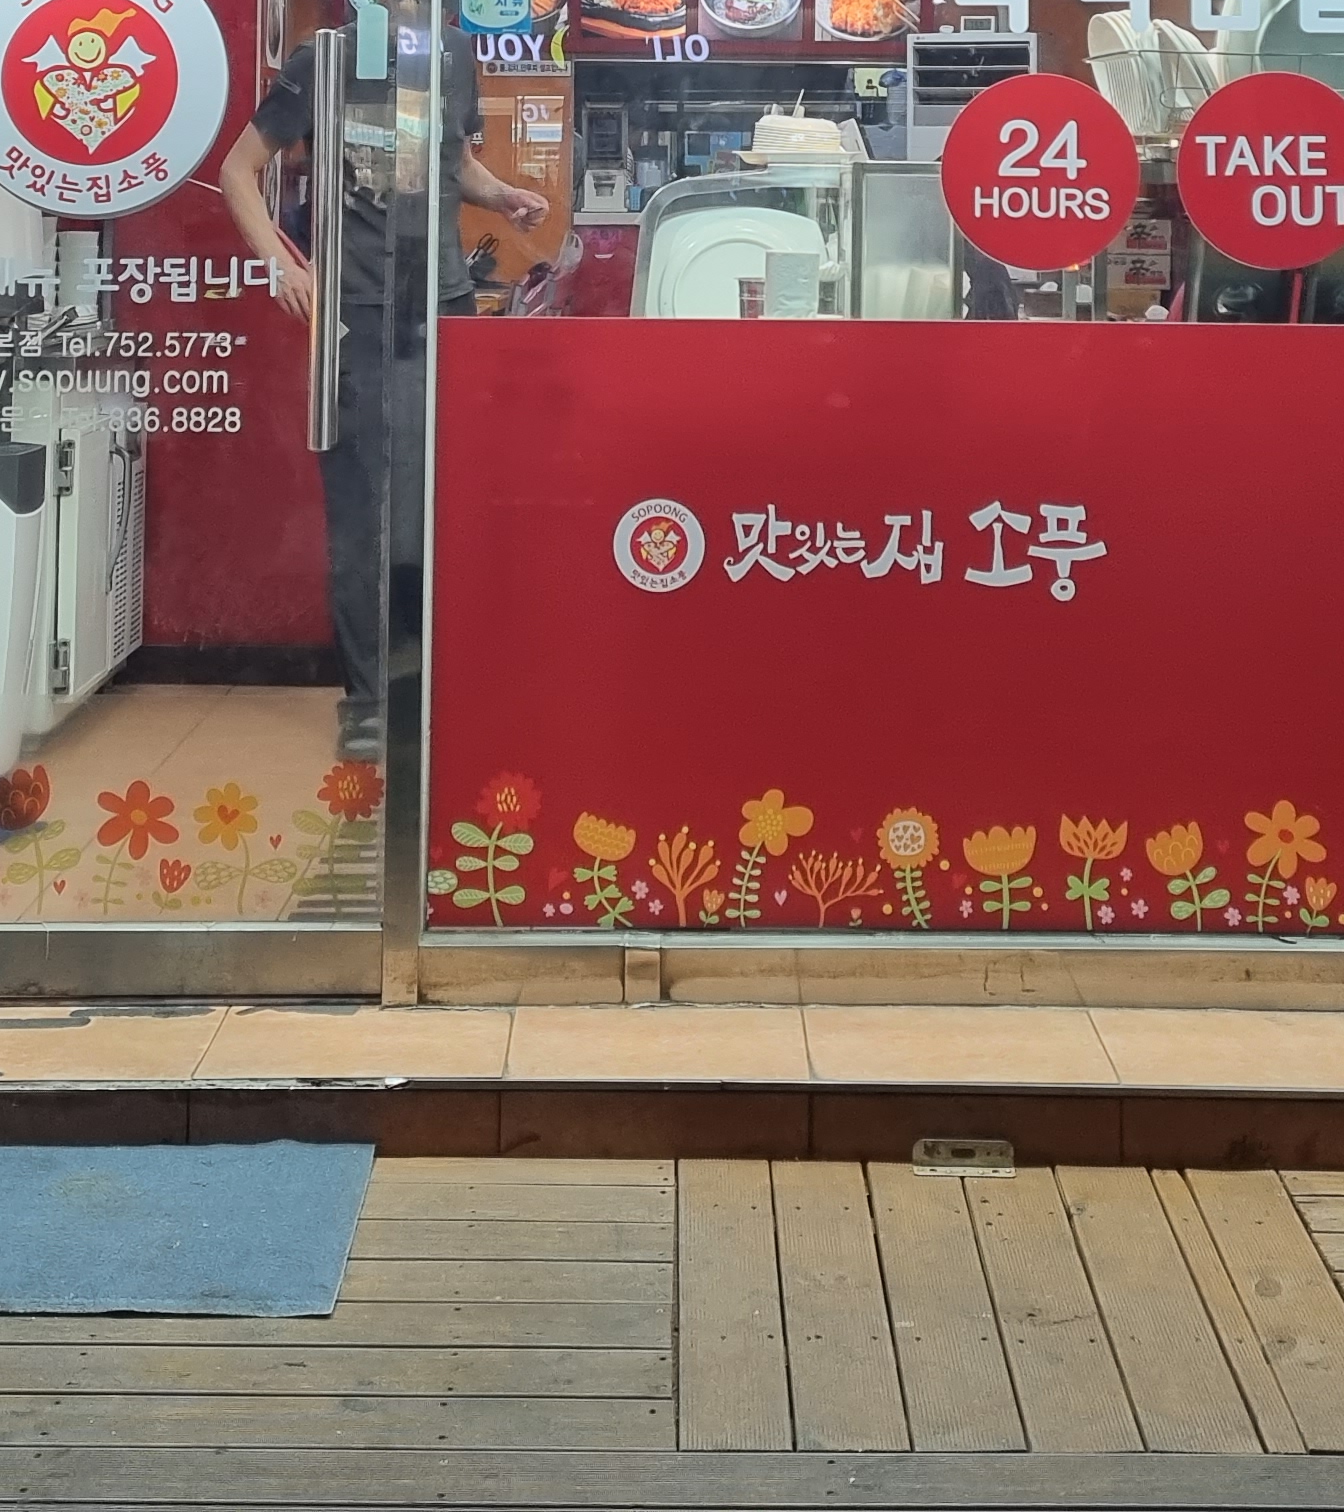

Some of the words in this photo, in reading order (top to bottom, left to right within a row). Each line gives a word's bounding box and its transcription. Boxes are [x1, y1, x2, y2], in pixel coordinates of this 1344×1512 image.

[998, 118, 1088, 180] 24
[1196, 134, 1328, 178] TAKE
[973, 185, 1111, 222] HOURS
[76, 255, 285, 305] 포장됩니다
[630, 502, 689, 525] SOPOONG
[723, 503, 945, 585] 맛있는집
[964, 500, 1108, 603] 소풍
